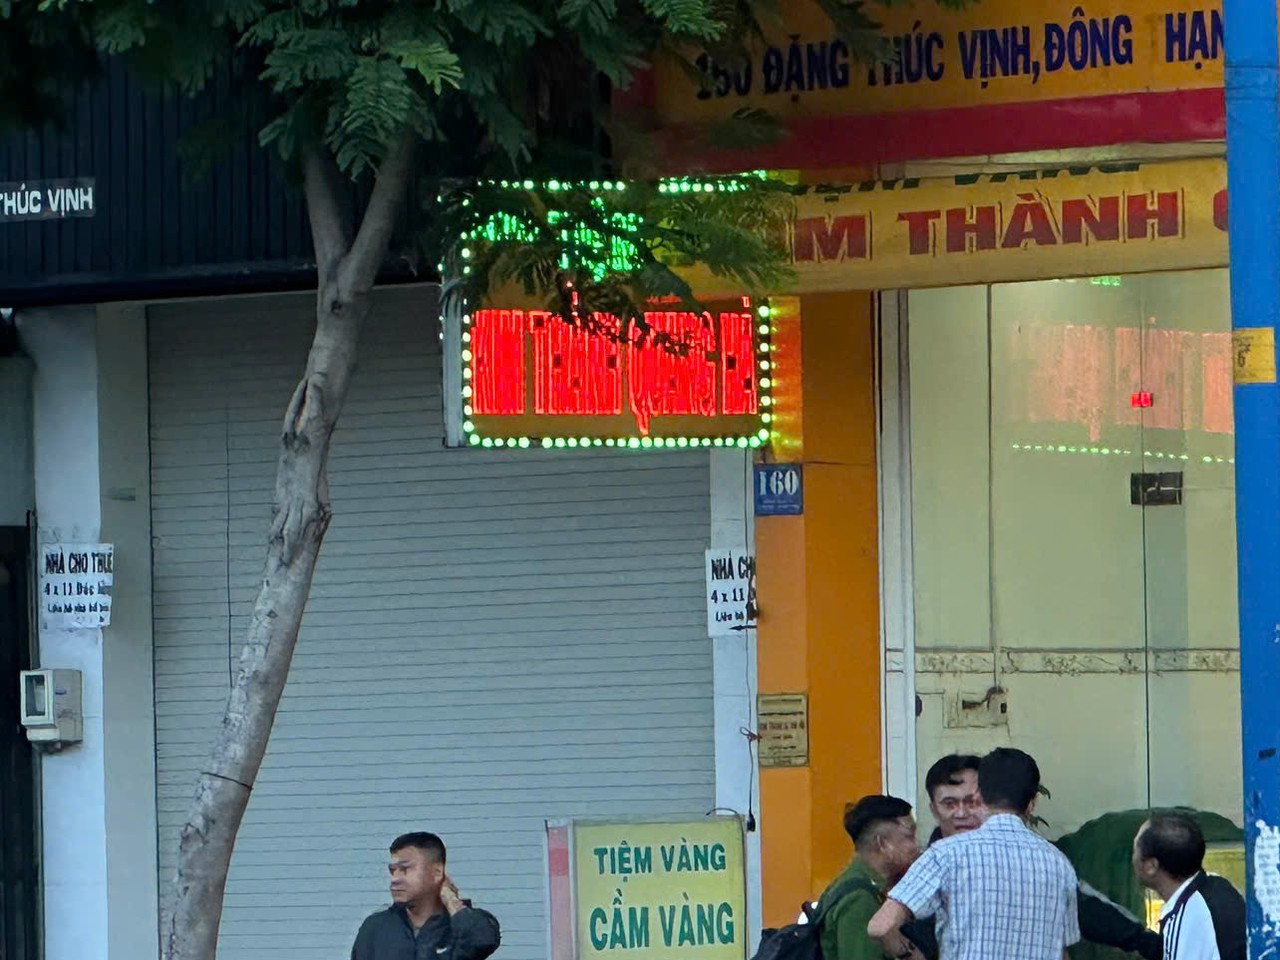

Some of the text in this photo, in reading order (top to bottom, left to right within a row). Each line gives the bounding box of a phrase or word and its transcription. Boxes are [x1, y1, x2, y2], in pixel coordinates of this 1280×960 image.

[762, 33, 849, 102] ĐẶNG
[47, 187, 94, 218] VỊNH
[898, 190, 1184, 257] THÀNH
[759, 470, 800, 497] 160
[593, 837, 726, 882] TIỆM VÀNG
[589, 888, 735, 951] CẦM VÀNG
